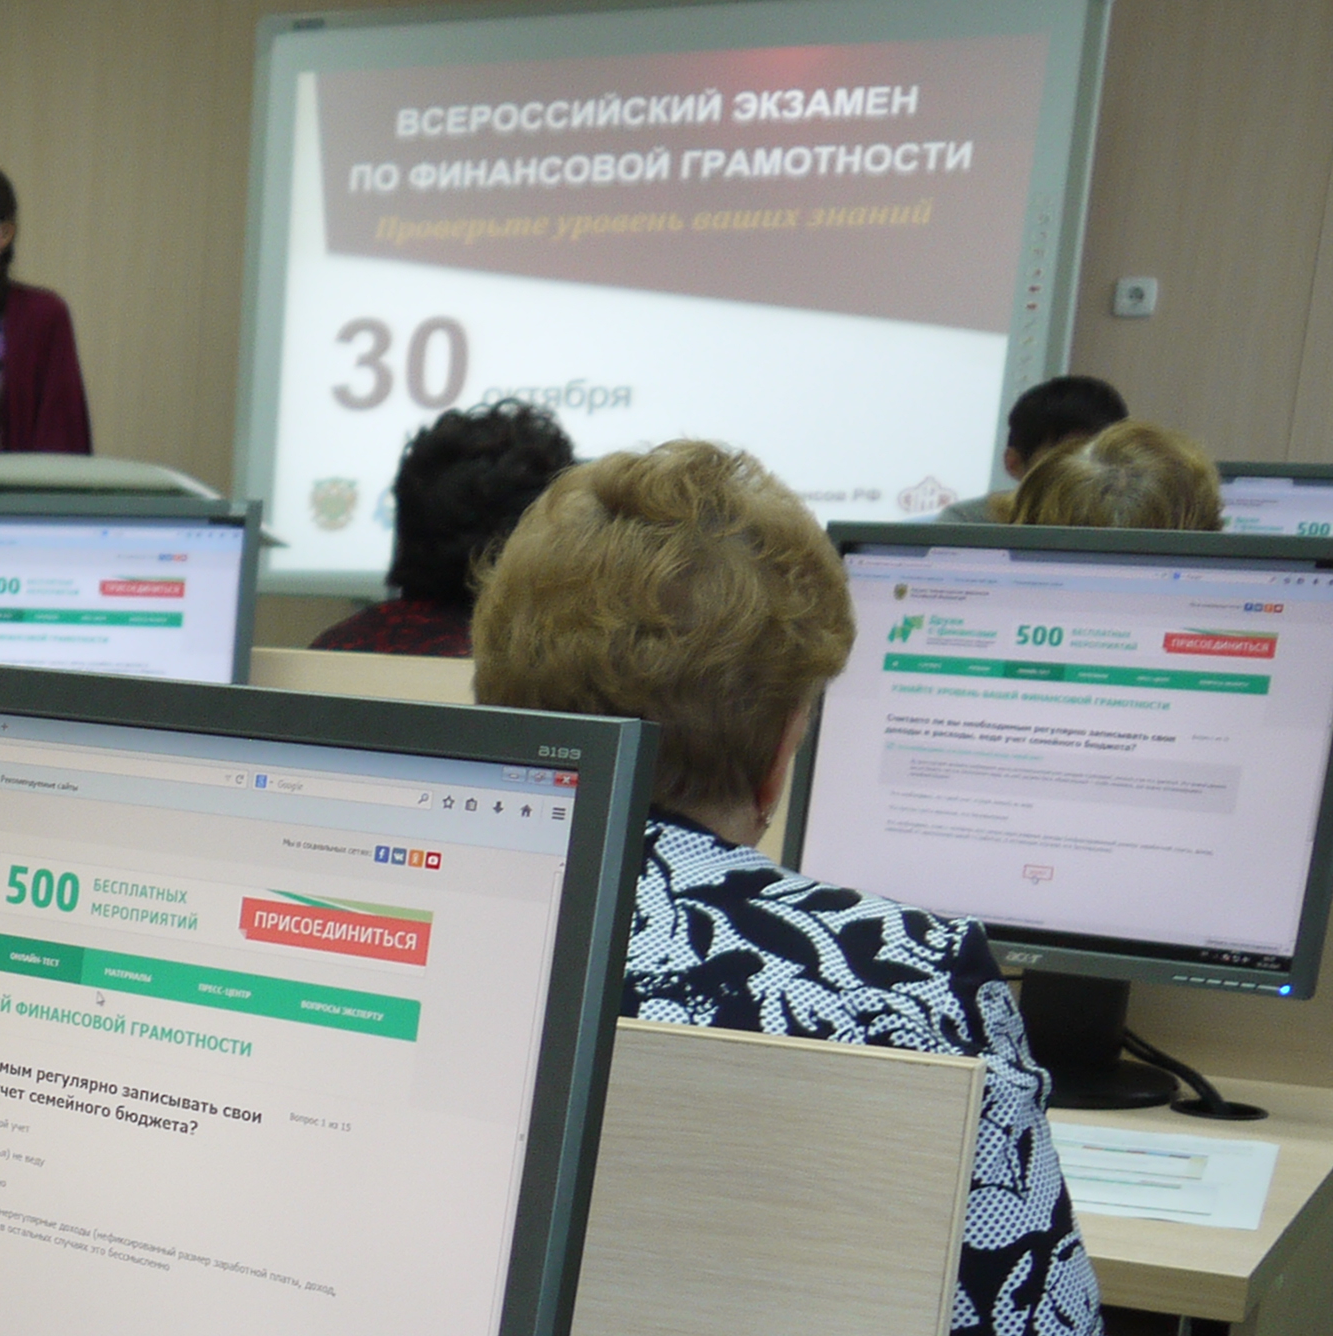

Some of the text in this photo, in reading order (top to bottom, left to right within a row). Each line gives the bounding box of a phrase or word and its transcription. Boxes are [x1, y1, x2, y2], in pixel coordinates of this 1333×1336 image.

[395, 86, 919, 139] ВСЕРОССИЙСКИЙ ЭКЗАМЕН
[347, 140, 974, 194] ПО ФИНАНСОВОЙ ГРАМОТНОСТИ
[376, 198, 933, 245] Проверьте уровень ваших знаний
[330, 315, 470, 411] 30
[481, 378, 634, 414] октября
[1015, 624, 1064, 647] 500
[277, 779, 304, 792] Google
[5, 864, 81, 913] 500
[93, 877, 188, 905] БЕСПЛАТНЫХ
[90, 901, 198, 931] МЕРОПРИЯТИЙ
[254, 910, 418, 952] ПРИСОЕДИНИТЬСЯ
[15, 1000, 126, 1035] ФИНАНСОВОЙ
[130, 1021, 253, 1058] ГРАМОТНОСТИ
[28, 1091, 111, 1118] семейного
[115, 1104, 199, 1135] бюджета?
[35, 1068, 118, 1095] регулярно
[121, 1084, 219, 1116] записывать
[222, 1105, 263, 1124] свои
